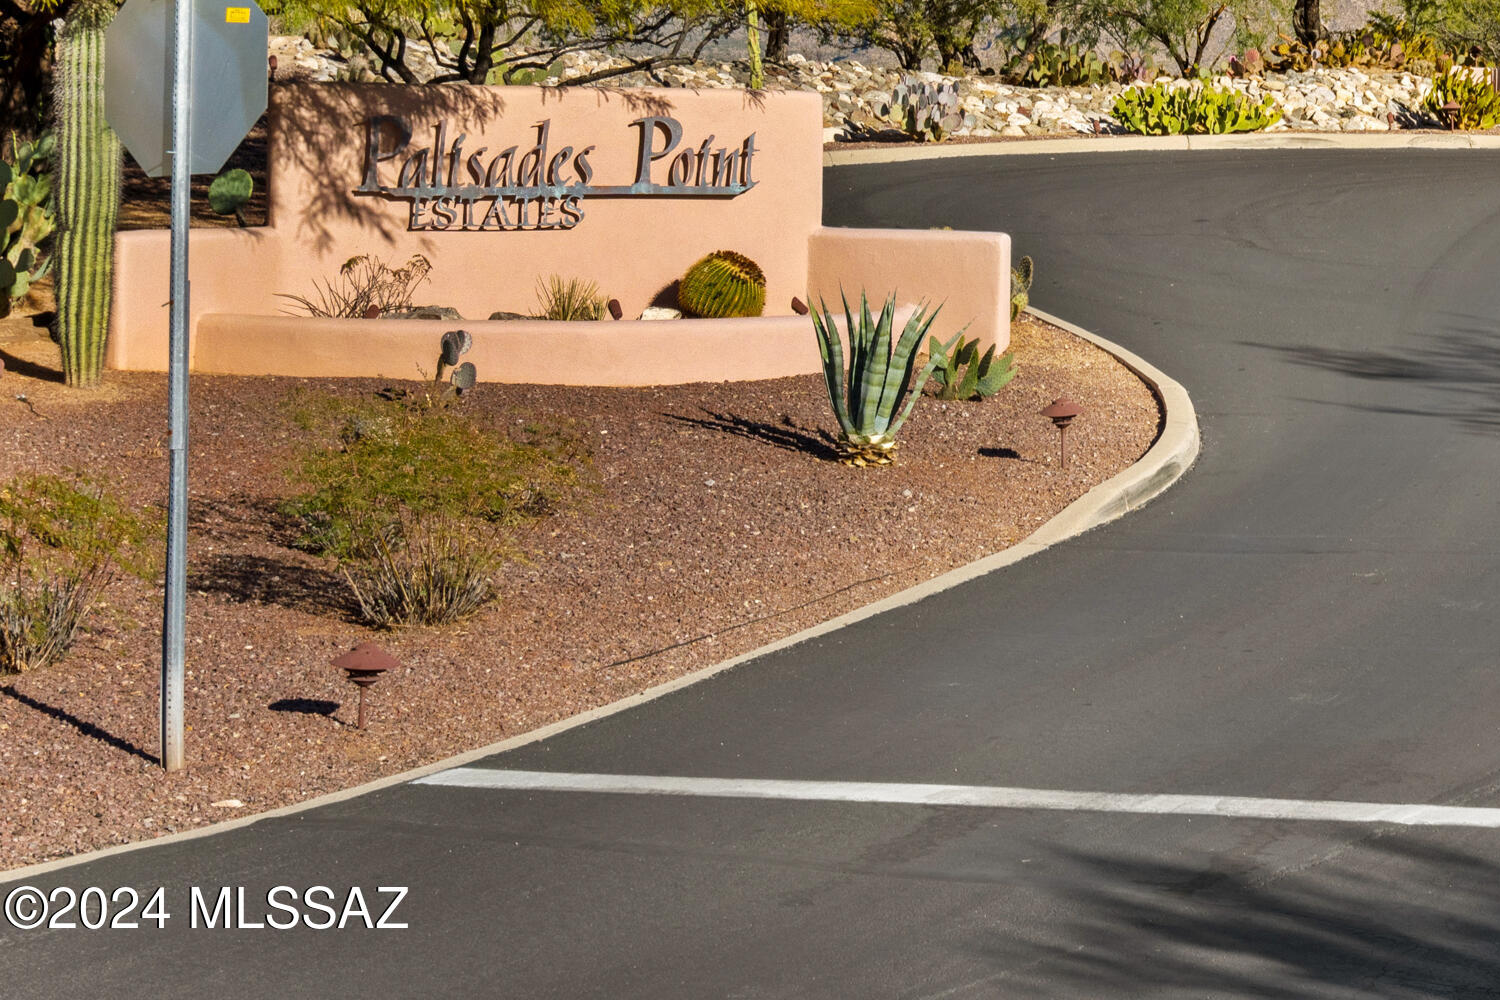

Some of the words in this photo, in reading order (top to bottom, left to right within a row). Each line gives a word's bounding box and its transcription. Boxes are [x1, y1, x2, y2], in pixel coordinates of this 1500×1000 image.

[353, 114, 596, 190] Palisades
[628, 115, 761, 188] Point
[407, 194, 586, 231] ESTATES
